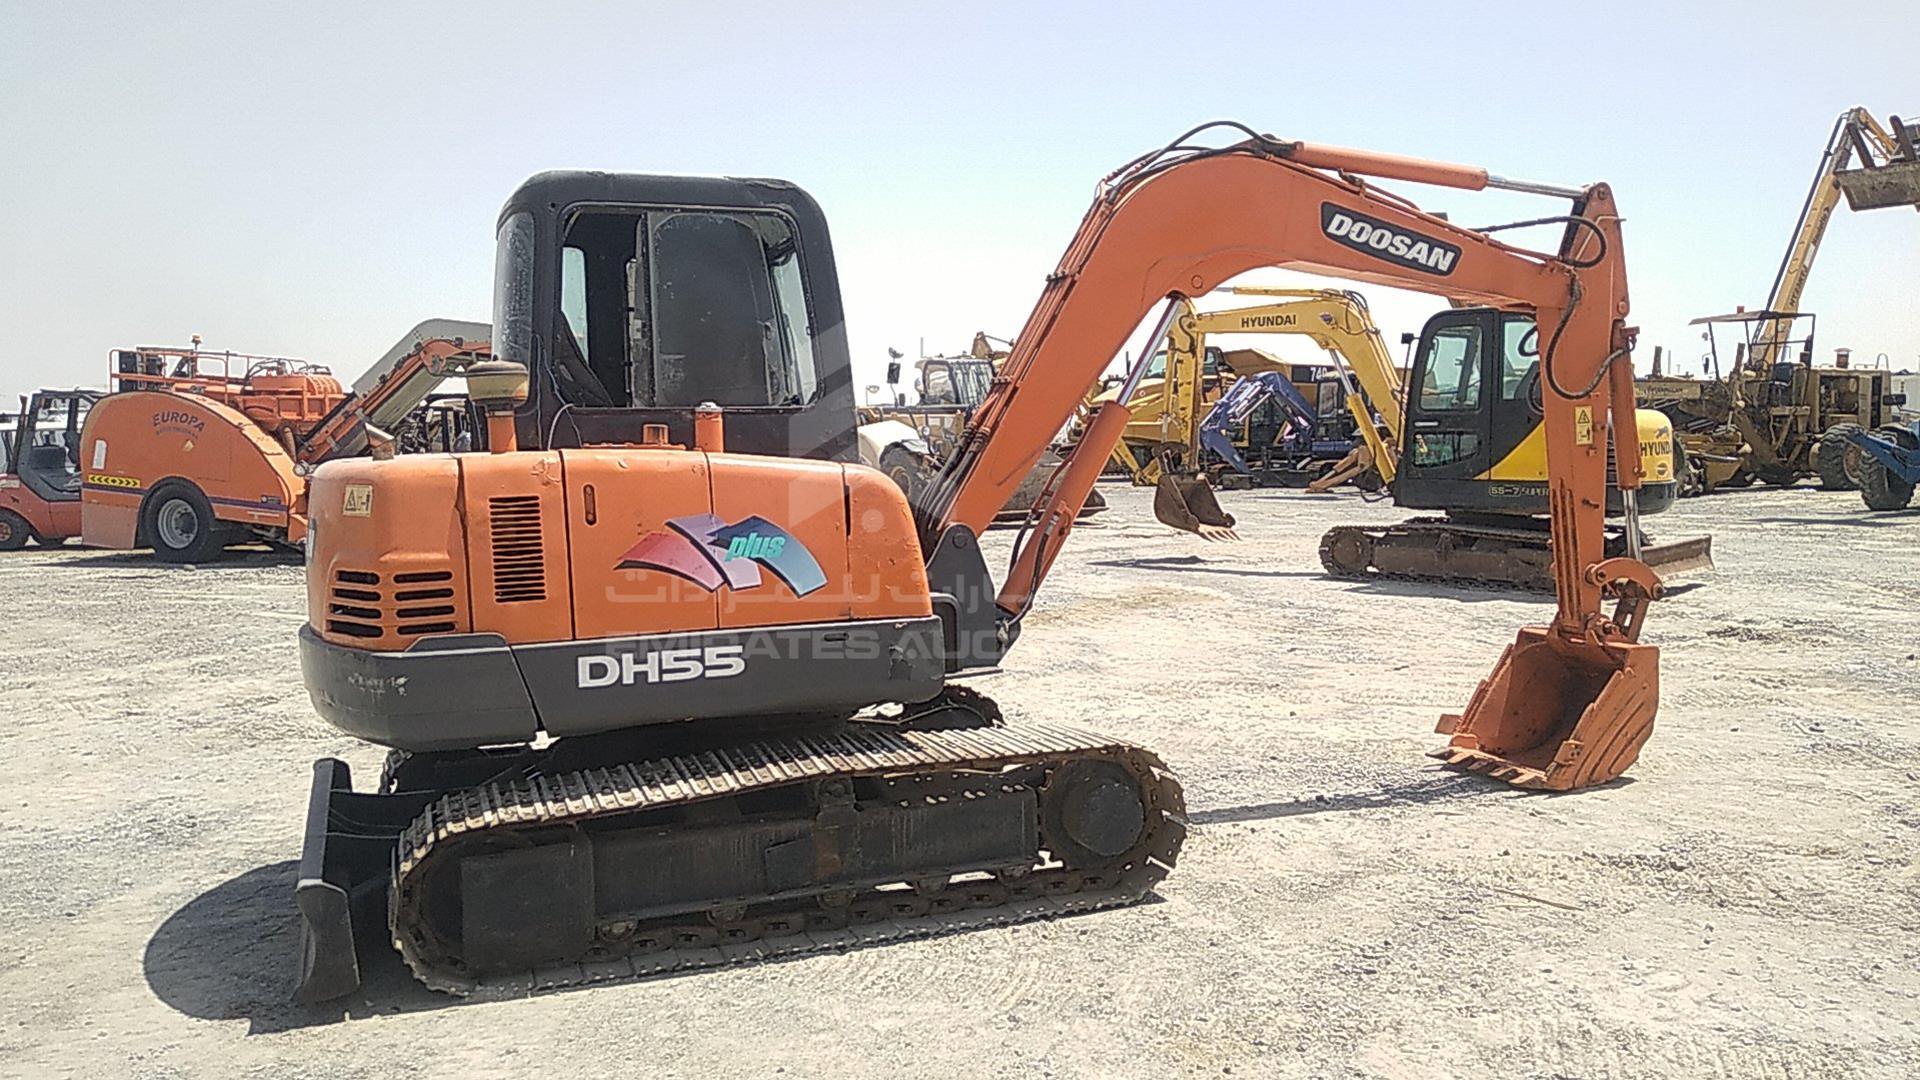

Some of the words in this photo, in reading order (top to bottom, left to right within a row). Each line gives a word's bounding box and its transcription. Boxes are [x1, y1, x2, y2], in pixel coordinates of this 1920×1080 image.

[1326, 212, 1456, 273] DOOSAN
[1241, 314, 1297, 328] HYUNDAI
[152, 411, 205, 432] EUROPA
[724, 532, 786, 562] plus
[577, 645, 746, 689] DH55
